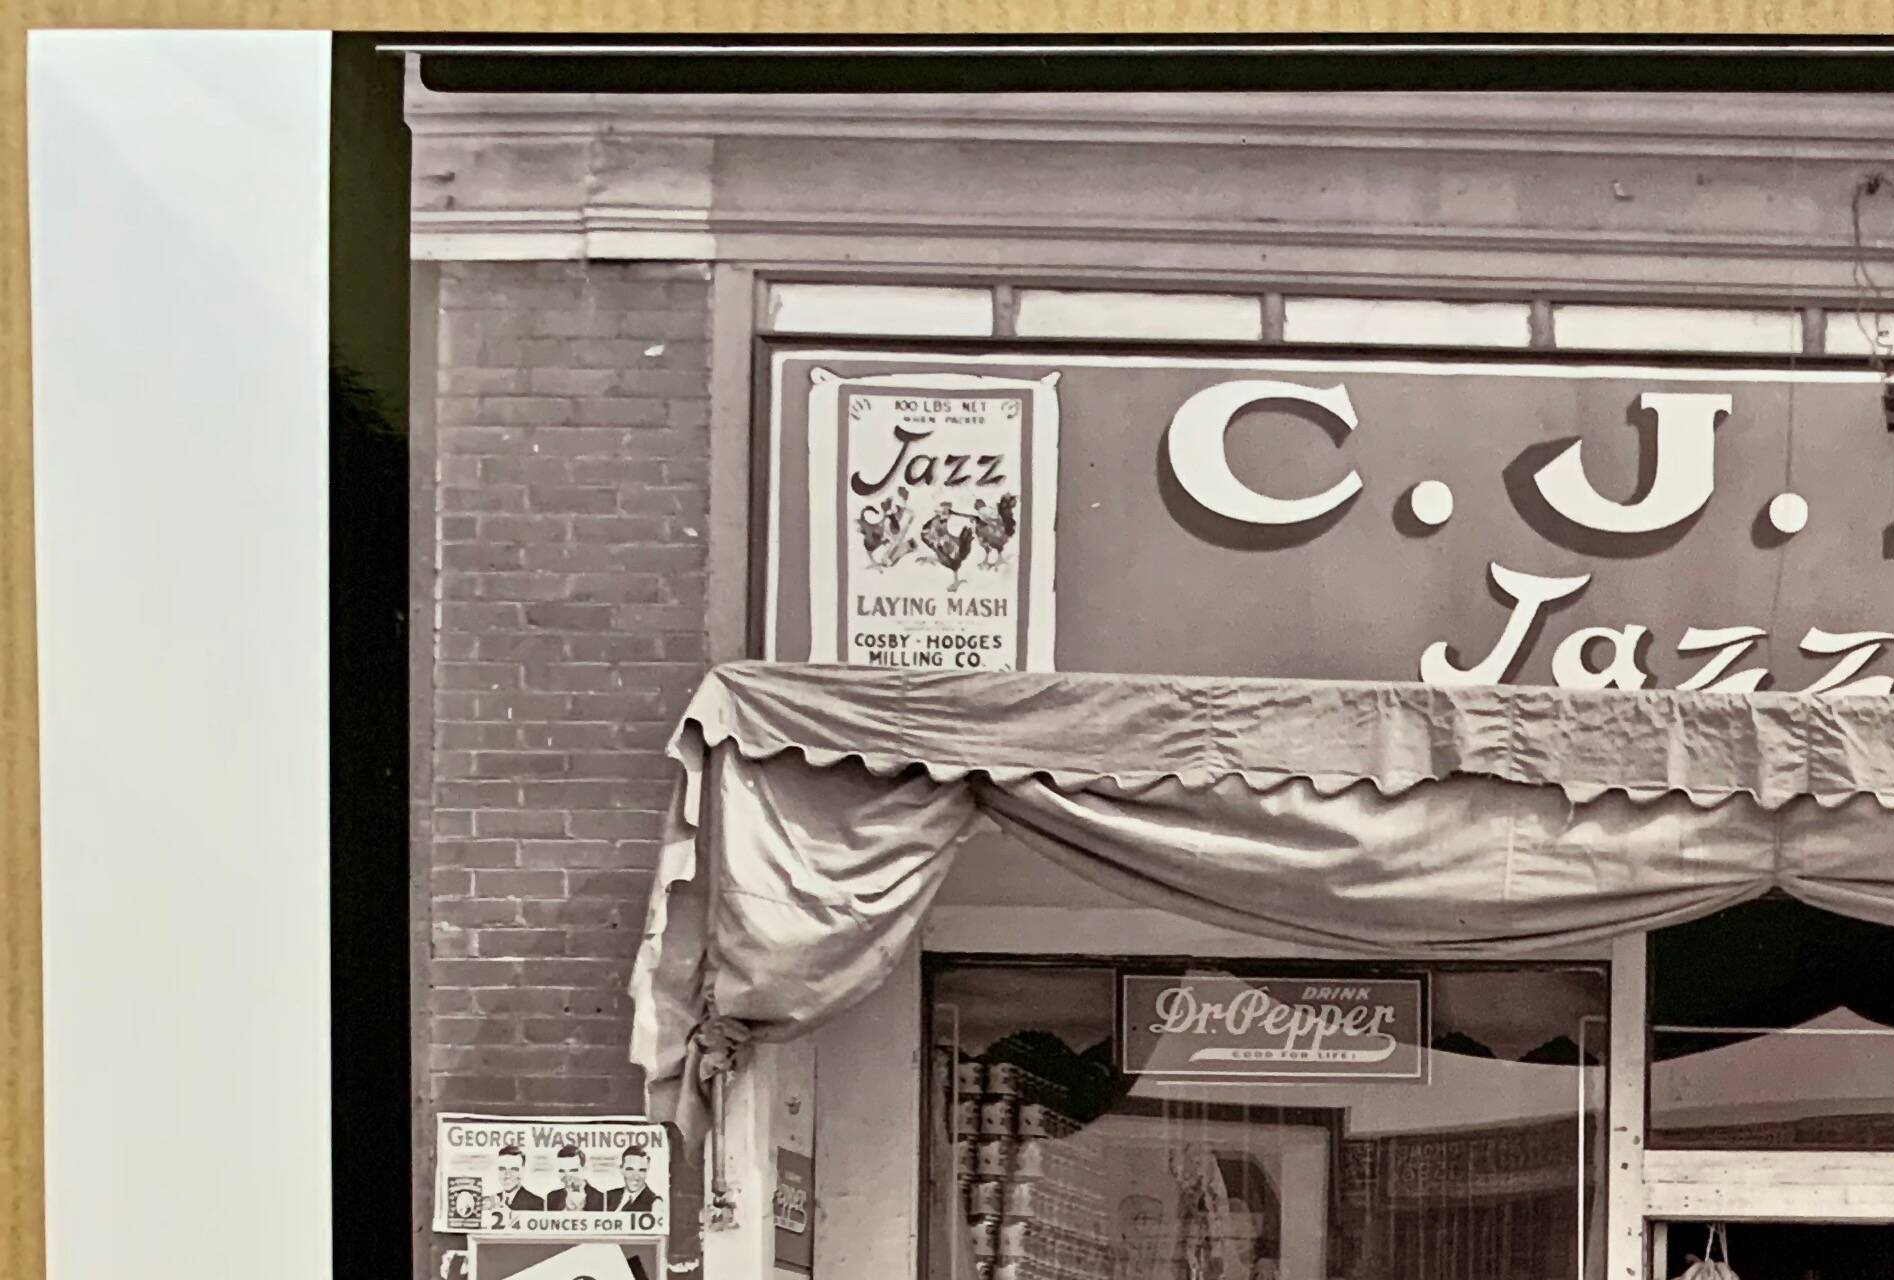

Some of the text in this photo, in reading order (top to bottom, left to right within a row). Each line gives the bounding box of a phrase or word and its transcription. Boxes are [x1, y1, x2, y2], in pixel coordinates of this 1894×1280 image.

[924, 400, 951, 412] LBS
[962, 401, 986, 412] NET
[851, 425, 1006, 496] Jazz
[857, 595, 1008, 617] LAYING MASH
[854, 632, 910, 648] COSBY
[927, 634, 1002, 650] HODGES
[869, 652, 985, 668] MILLING CO.
[1301, 987, 1372, 1001] DRINK
[449, 1126, 662, 1150] GEORGE WASHINGTON
[527, 1218, 588, 1232] OUNCES
[594, 1218, 623, 1231] FOR
